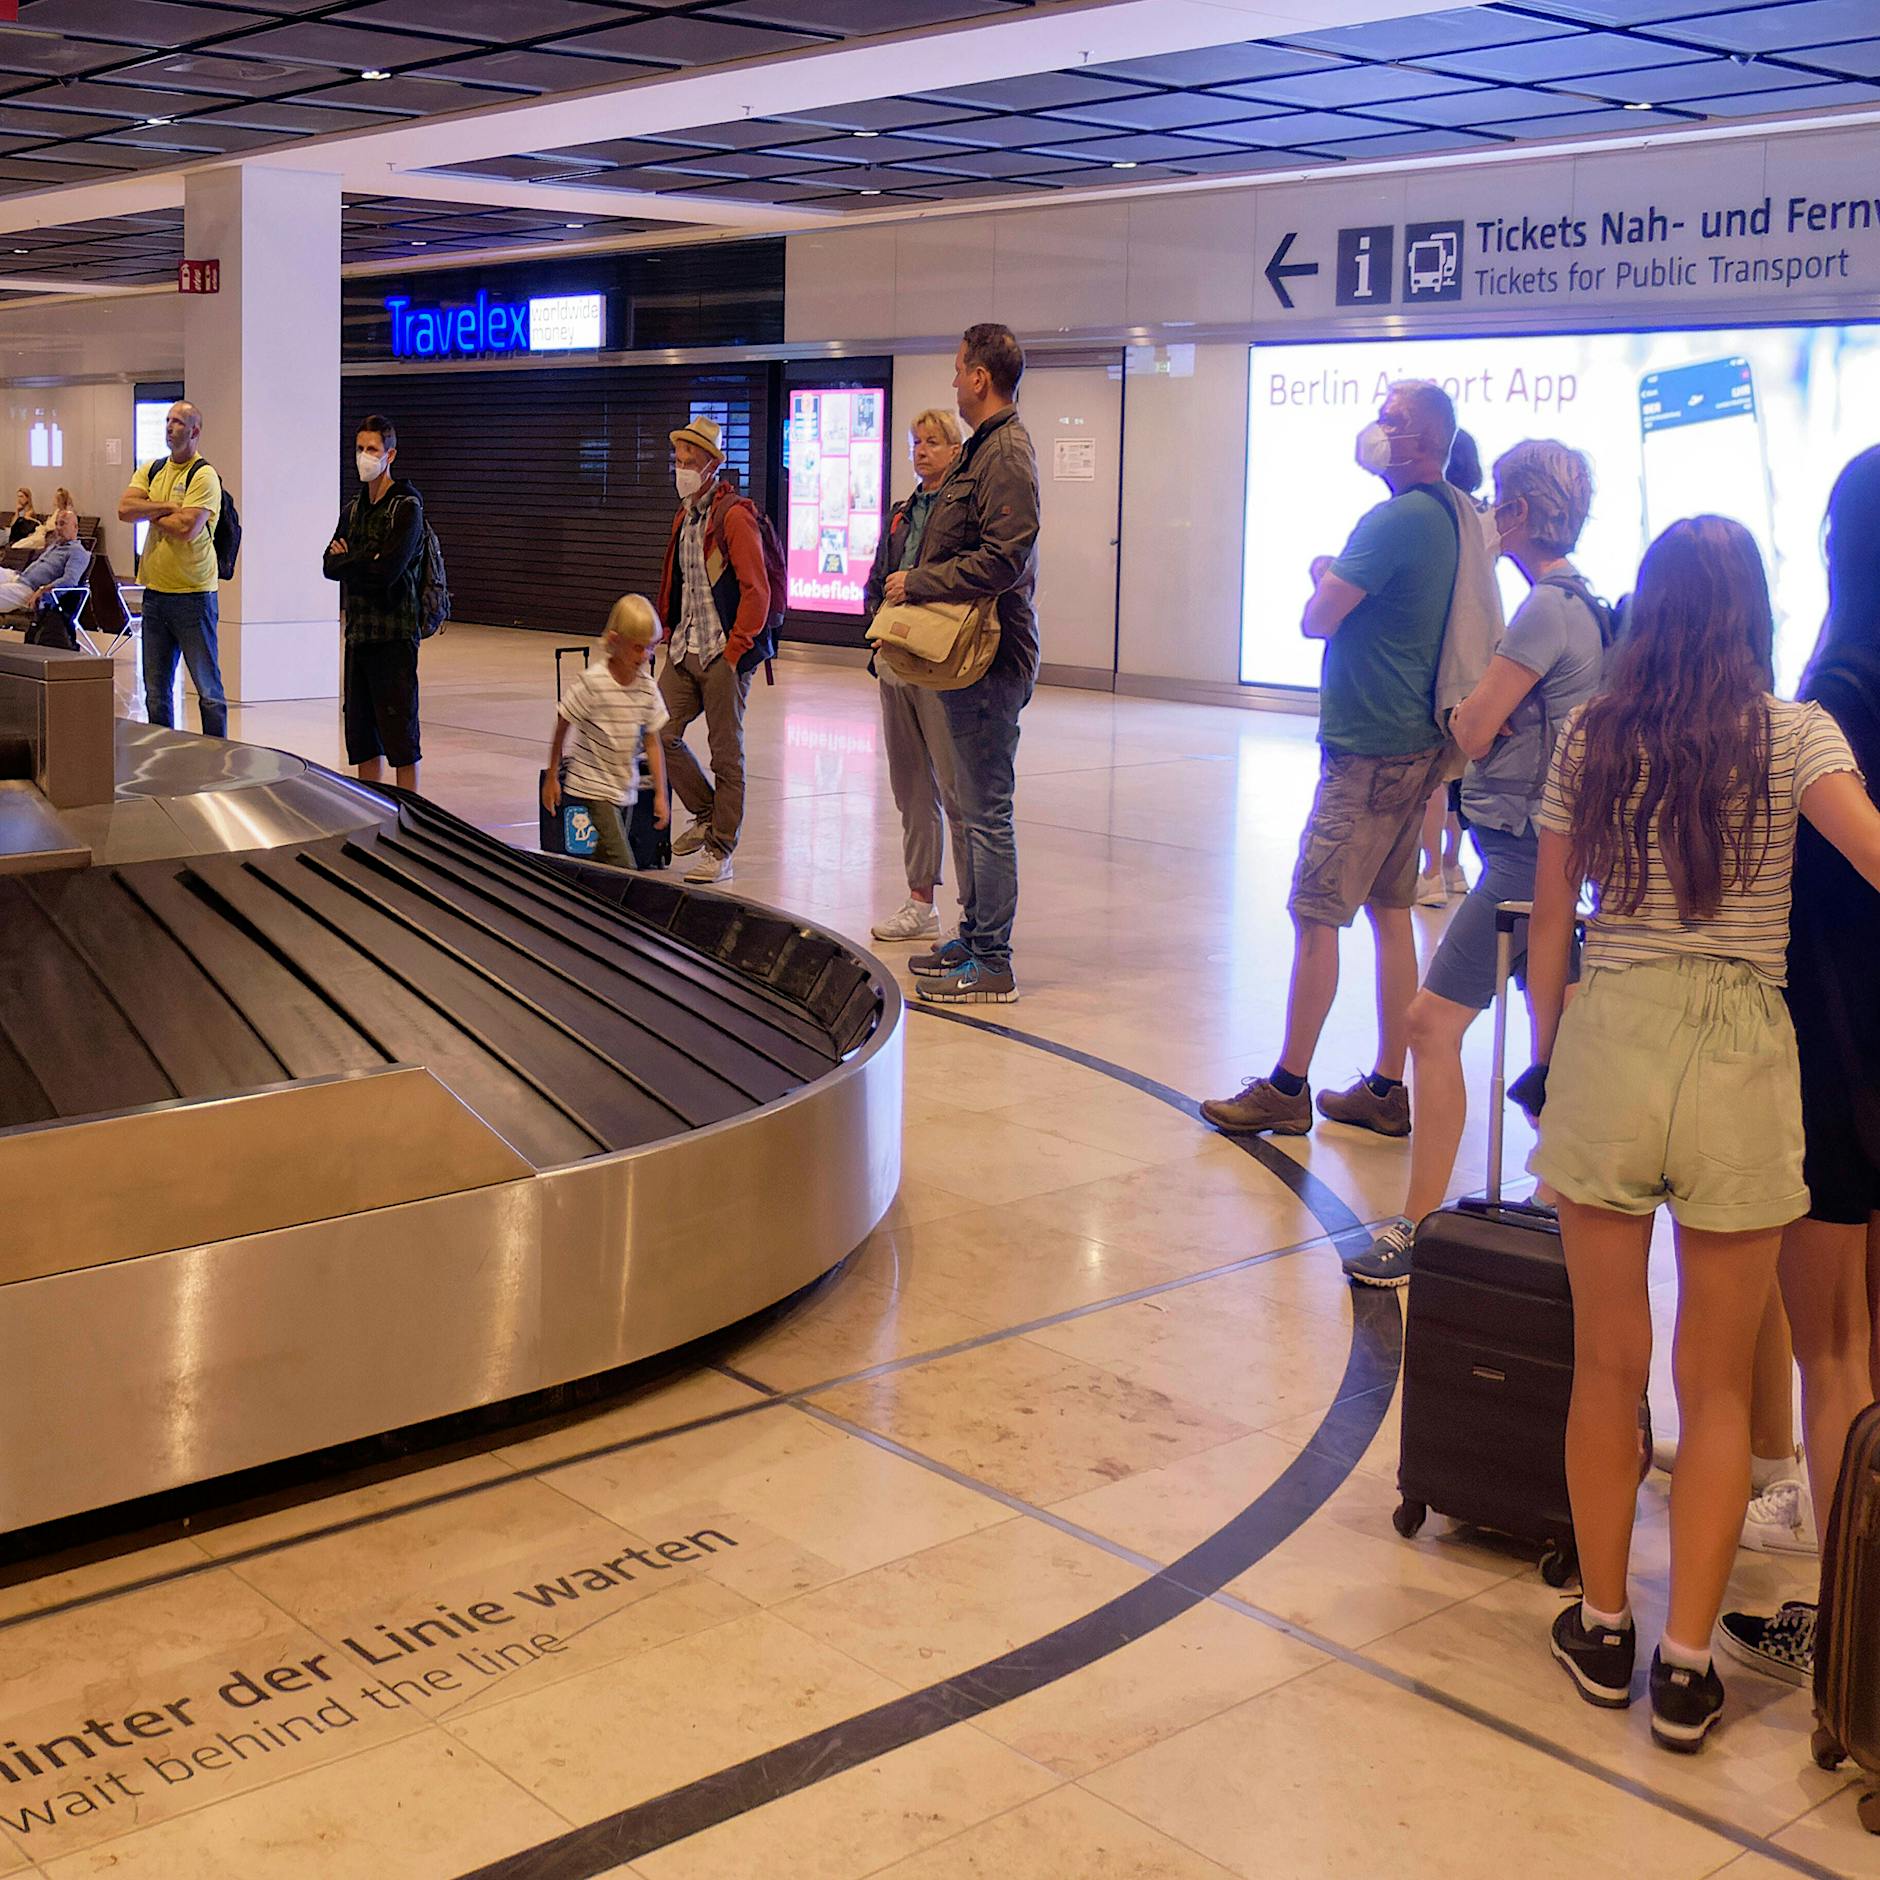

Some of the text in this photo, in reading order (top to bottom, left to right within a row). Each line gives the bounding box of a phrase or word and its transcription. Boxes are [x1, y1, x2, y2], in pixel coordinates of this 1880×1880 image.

[1476, 216, 1588, 253] Tickets
[1601, 206, 1685, 246] Nah-
[1702, 197, 1772, 239] und
[1475, 248, 1850, 296] Tickets for Public Transport
[386, 290, 531, 355] Travelex
[532, 299, 599, 321] worldwide
[533, 325, 576, 346] money
[1269, 367, 1578, 414] Berlin Aort App
[218, 1654, 333, 1709] der
[342, 1602, 516, 1666] Linie
[513, 1528, 739, 1609] warten
[0, 1633, 569, 1834] wait behind the line
